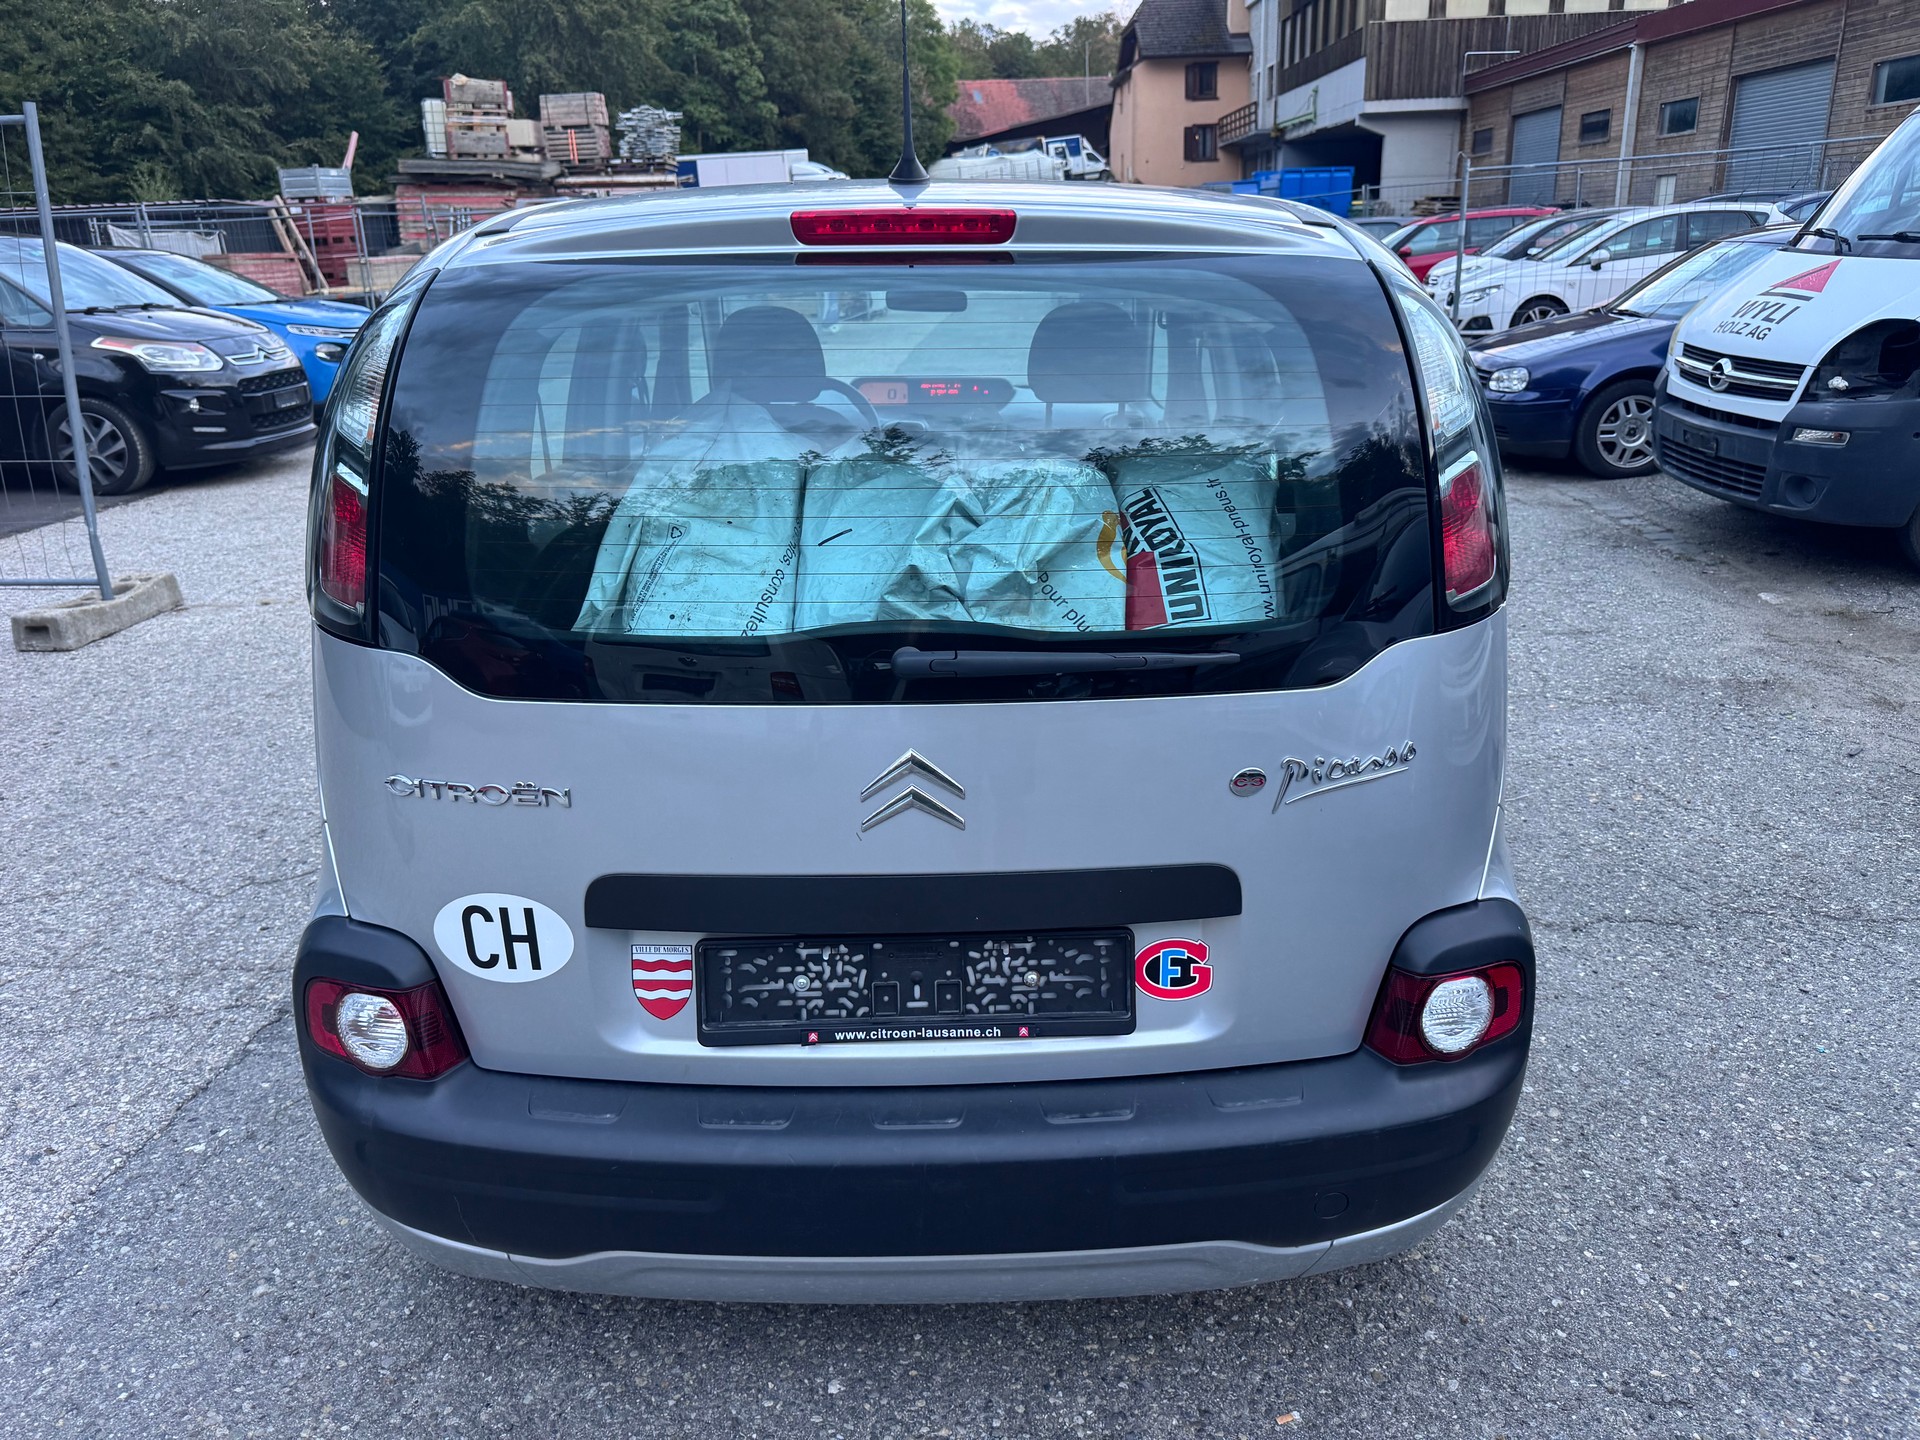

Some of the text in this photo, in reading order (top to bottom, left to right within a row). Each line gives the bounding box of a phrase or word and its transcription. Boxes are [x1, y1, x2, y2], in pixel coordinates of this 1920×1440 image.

[1713, 320, 1772, 341] HOLZ AG
[1731, 300, 1801, 325] WYLI
[1125, 488, 1205, 621] UNIROYAL
[1038, 571, 1094, 632] Pour plu
[384, 774, 572, 808] CITROËN
[1271, 740, 1417, 814] Picasso
[461, 904, 542, 970] CH
[834, 1027, 1001, 1041] www.citroen-lausanne.ch
